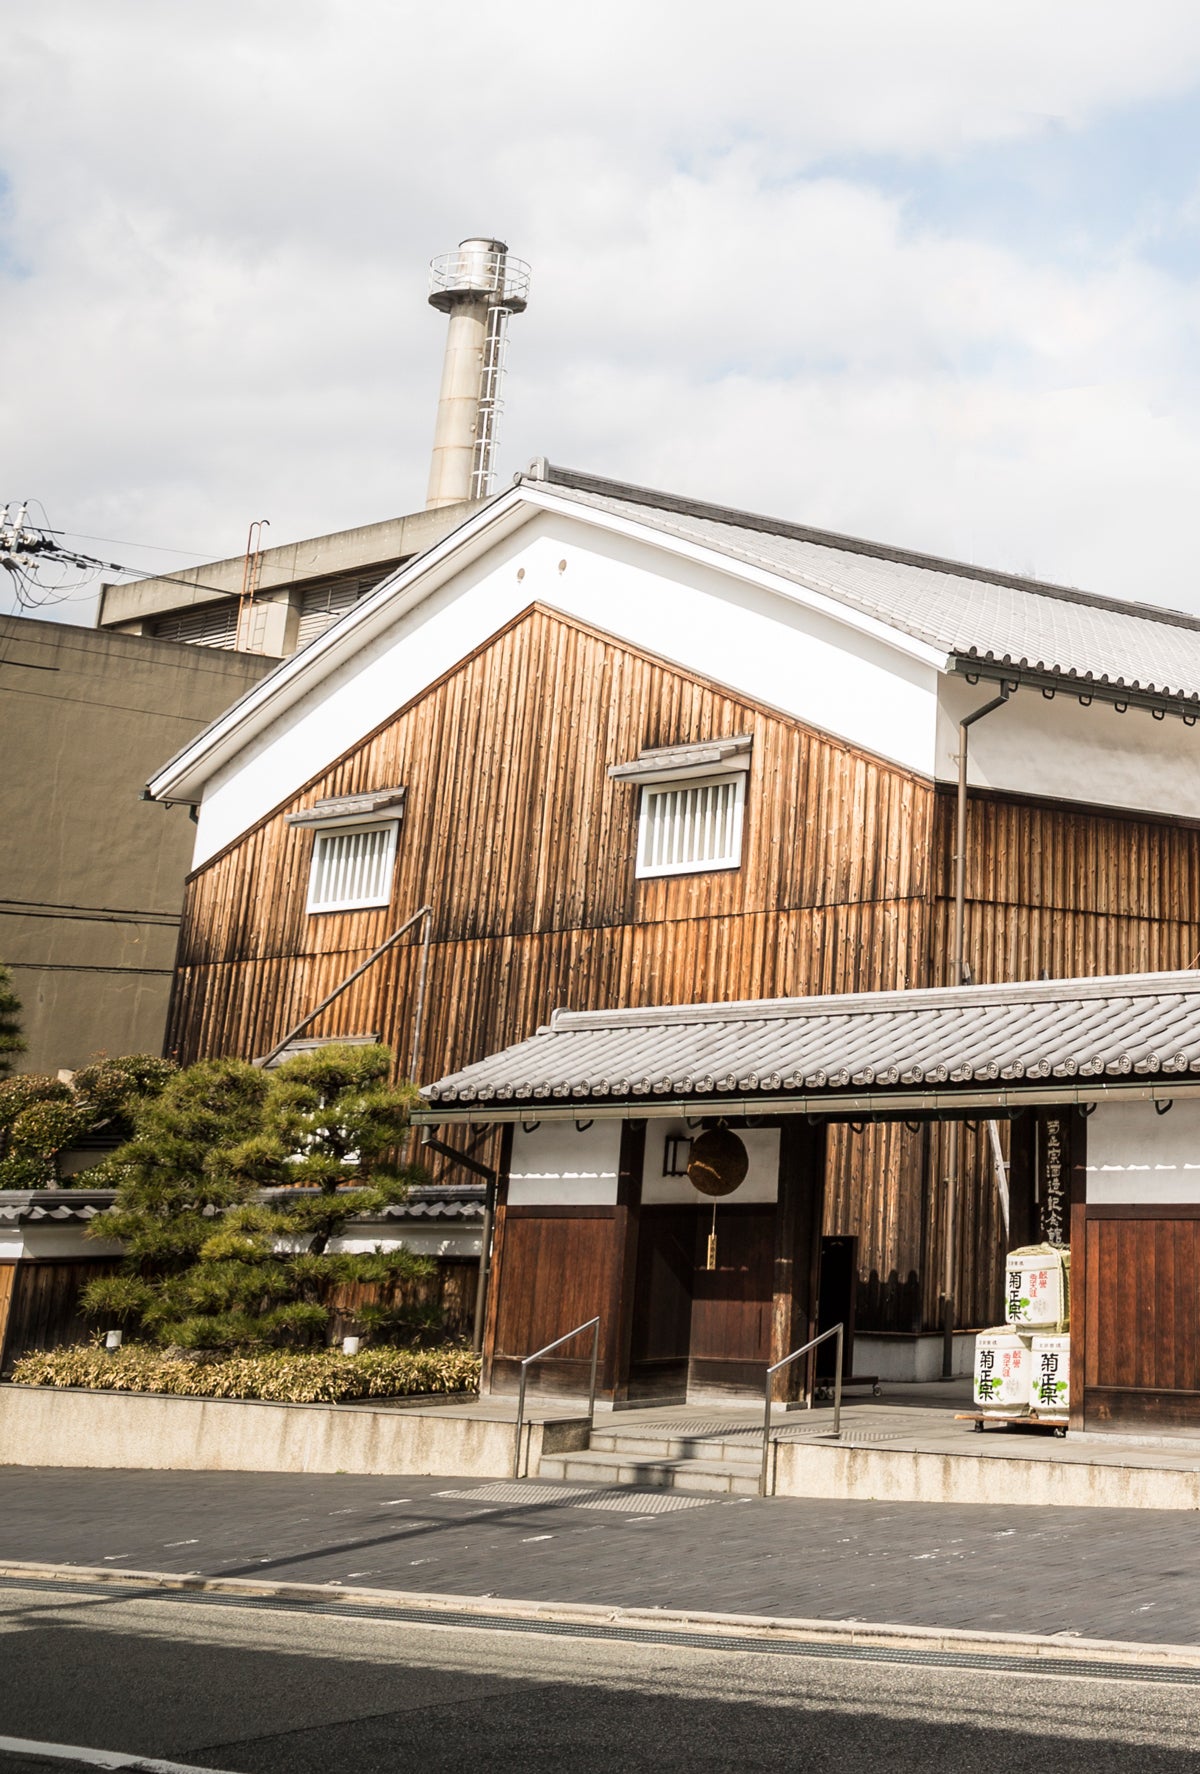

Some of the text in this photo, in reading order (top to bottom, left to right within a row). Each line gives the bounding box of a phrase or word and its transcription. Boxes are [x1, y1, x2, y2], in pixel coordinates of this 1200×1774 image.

[1009, 1271, 1022, 1321] 菊正宗
[980, 1349, 995, 1401] 菊正宗
[1041, 1353, 1059, 1406] 菊正宗
